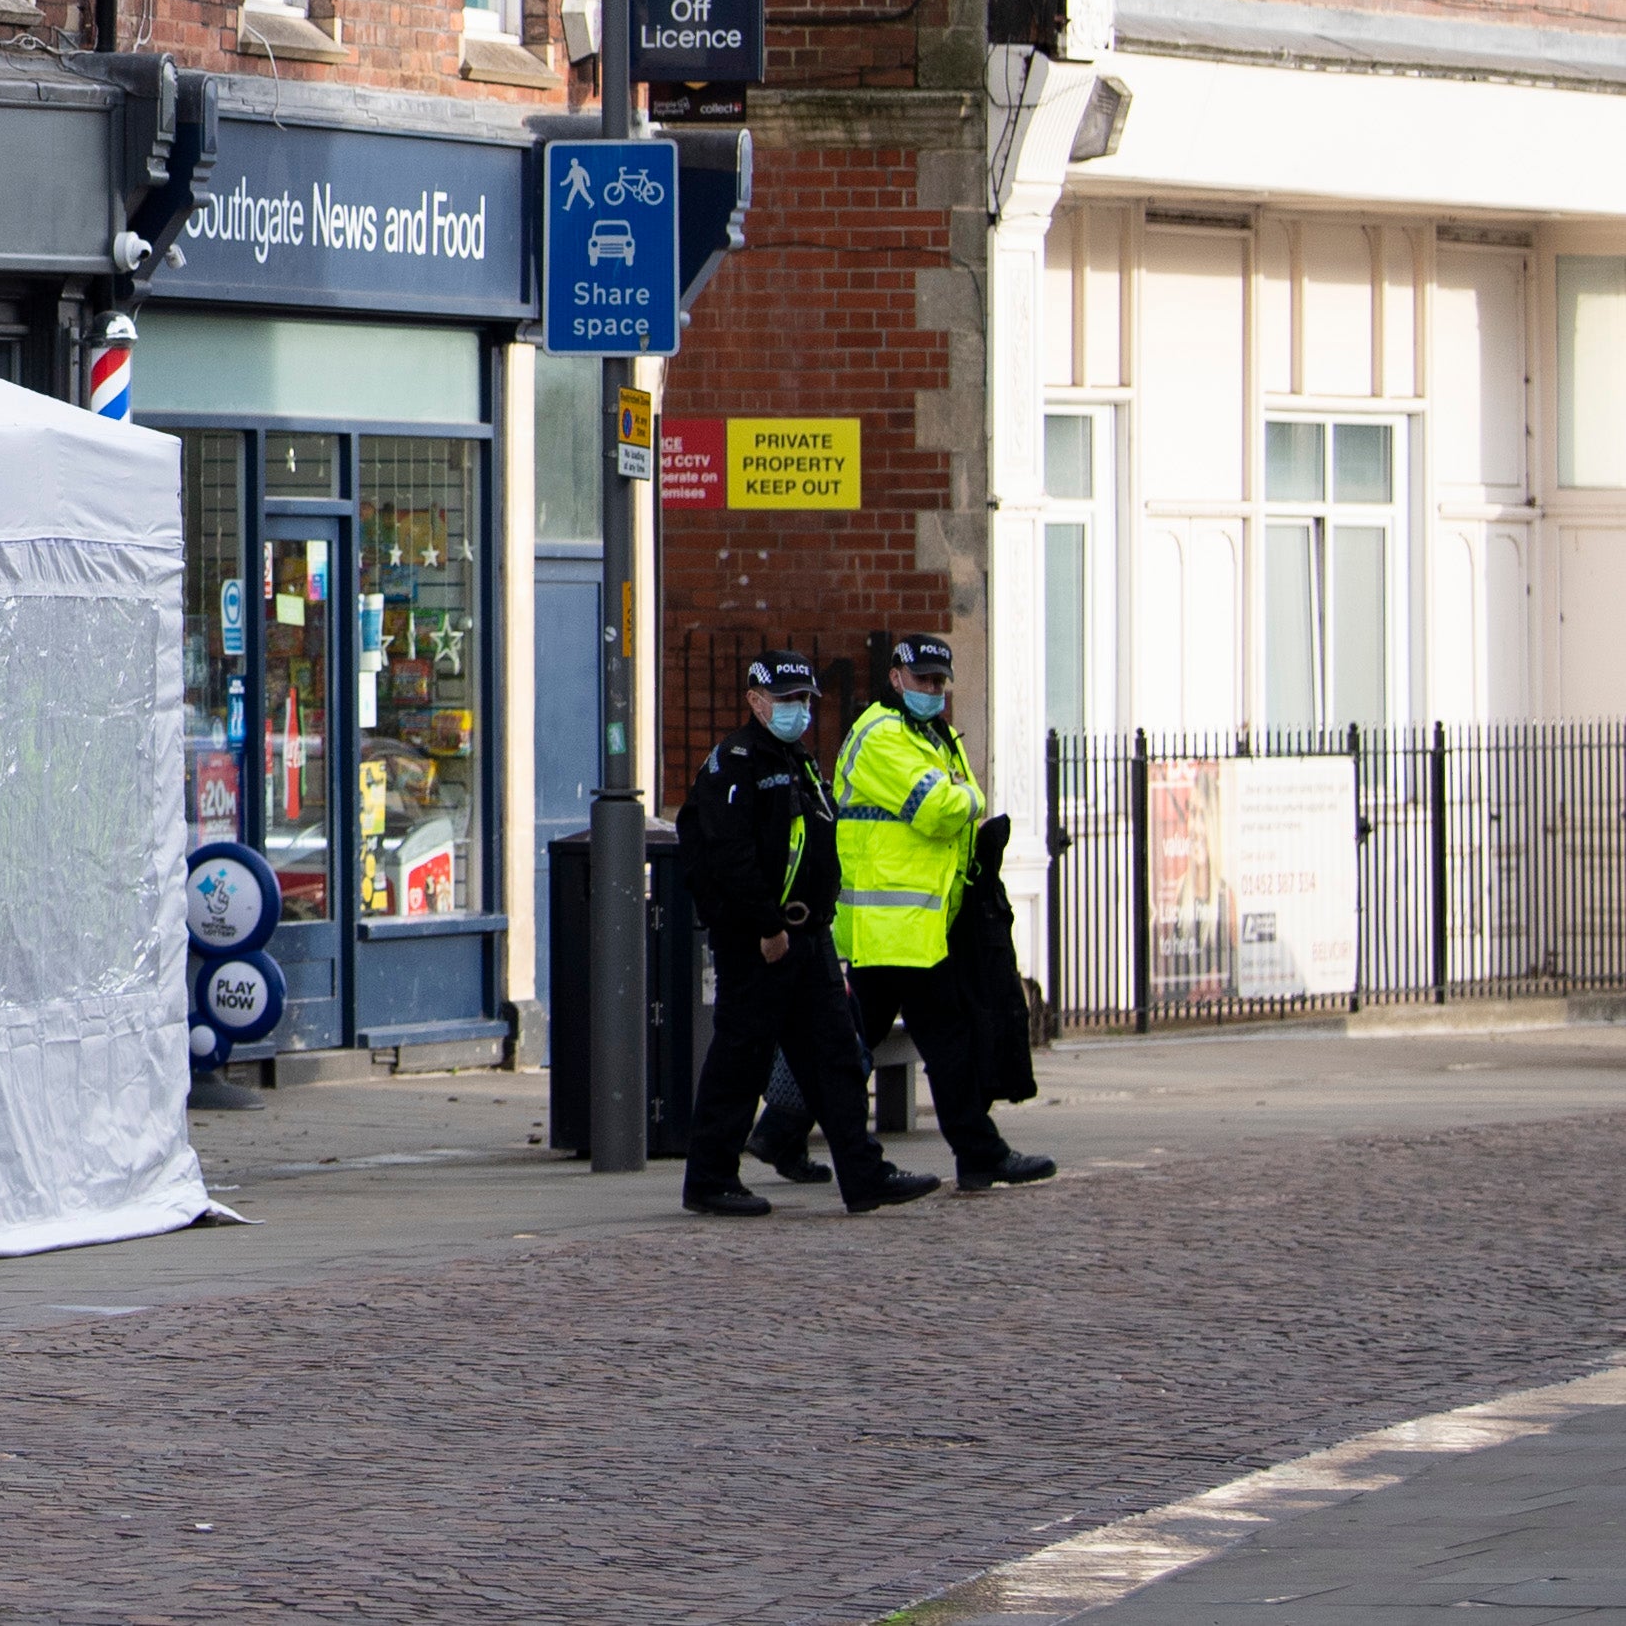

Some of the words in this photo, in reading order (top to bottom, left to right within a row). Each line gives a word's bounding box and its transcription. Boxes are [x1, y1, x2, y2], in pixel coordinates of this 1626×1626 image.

[640, 25, 743, 50] Licence
[312, 183, 377, 252] News
[384, 191, 428, 255] and
[432, 191, 486, 260] Food
[573, 282, 650, 305] Share
[573, 316, 650, 340] space
[754, 432, 832, 450] PRIVATE
[674, 455, 710, 468] CCTV
[743, 455, 846, 473] PROPERTY
[701, 472, 718, 483] on
[745, 479, 796, 497] KEEP
[801, 479, 842, 496] OUT
[776, 664, 810, 677] POLICE
[200, 779, 237, 817] £20M
[201, 922, 236, 931] NATIONAL
[212, 916, 226, 924] THE
[203, 930, 237, 938] LOTTERY
[216, 978, 257, 996] PLAY
[216, 994, 255, 1011] NOW
